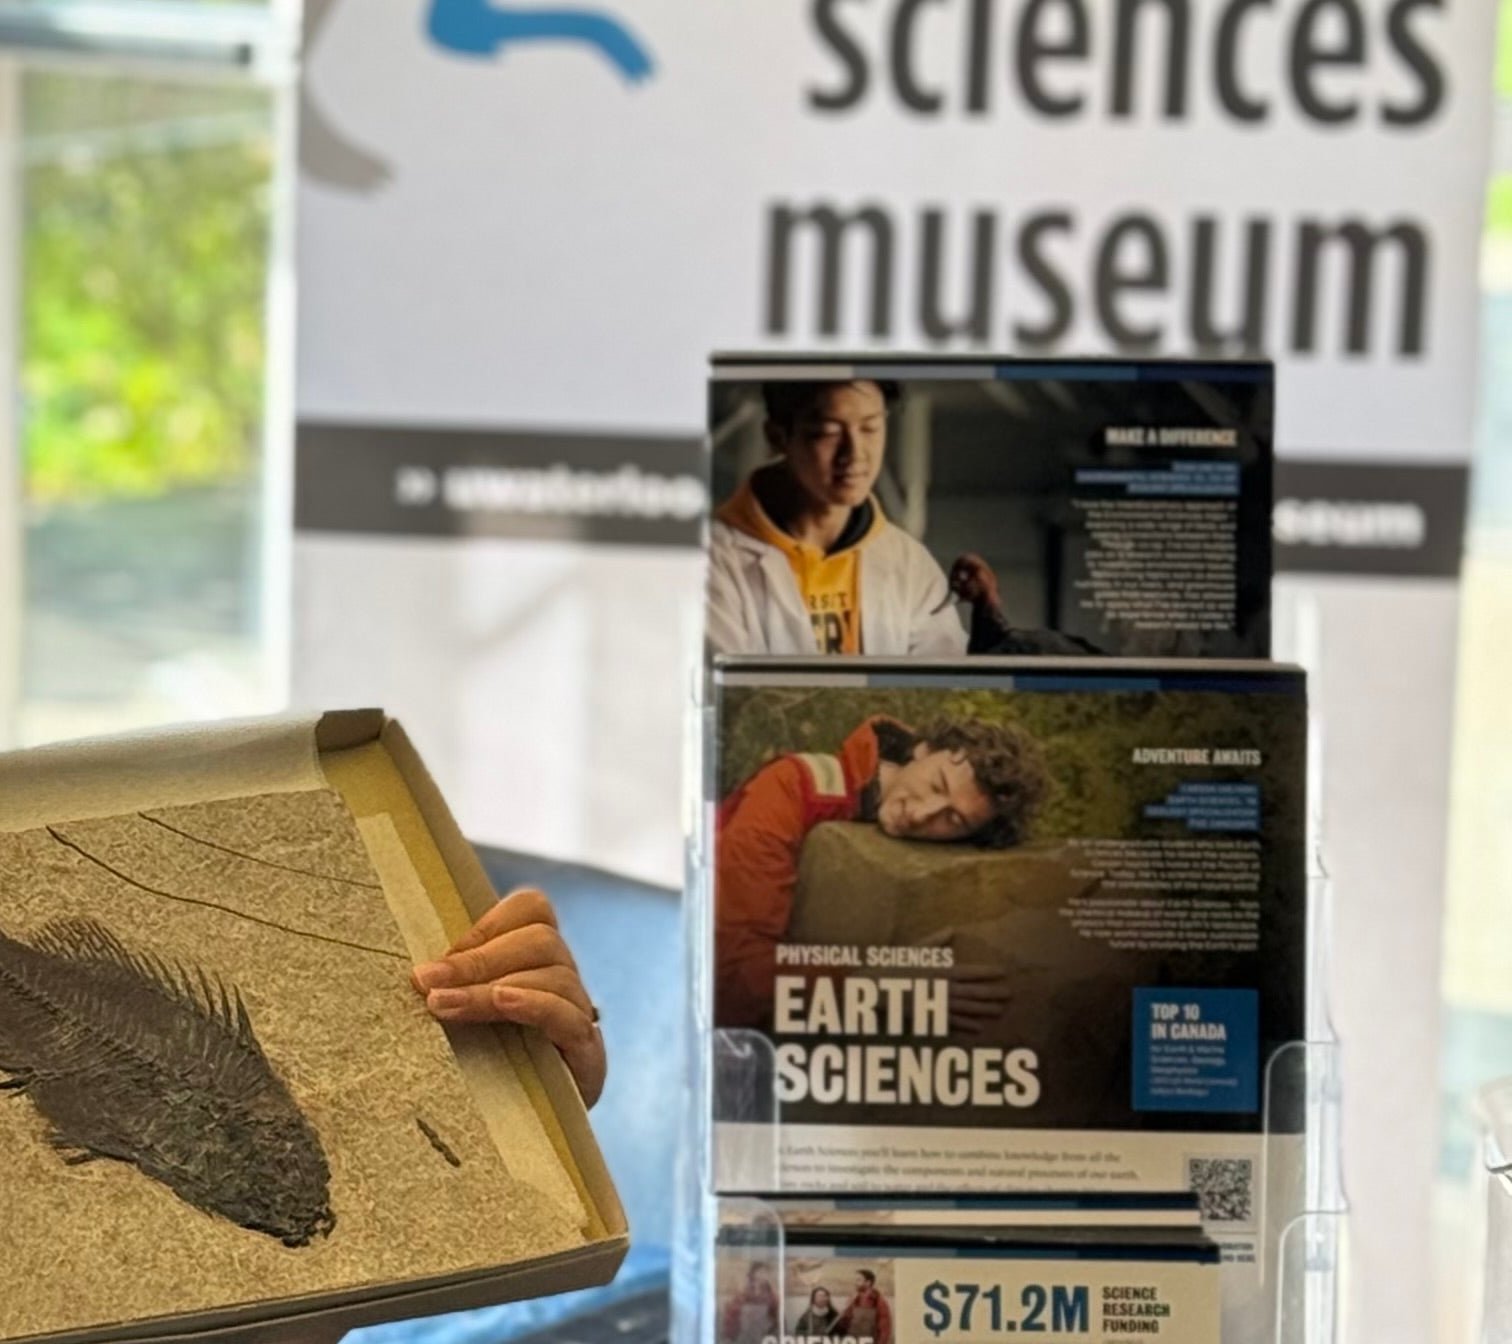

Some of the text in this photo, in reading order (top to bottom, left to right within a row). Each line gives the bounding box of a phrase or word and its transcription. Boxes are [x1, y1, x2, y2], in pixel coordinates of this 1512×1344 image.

[764, 202, 1434, 360] museum
[1105, 427, 1144, 445] MAKE
[1146, 428, 1158, 446] A
[1132, 747, 1262, 766] ADVENTURE AWAITS
[776, 944, 954, 968] PHYSICAL SCIENCES
[774, 976, 949, 1037] EARTH
[1151, 1003, 1200, 1021] TOP 10
[1151, 1023, 1227, 1040] IN CANADA
[773, 1044, 1040, 1107] SCIENCES
[1102, 1286, 1157, 1300] SCIENCE
[922, 1280, 1089, 1337] $71.2M
[1102, 1303, 1170, 1317] RESEARCH
[1102, 1319, 1160, 1333] FUNDING
